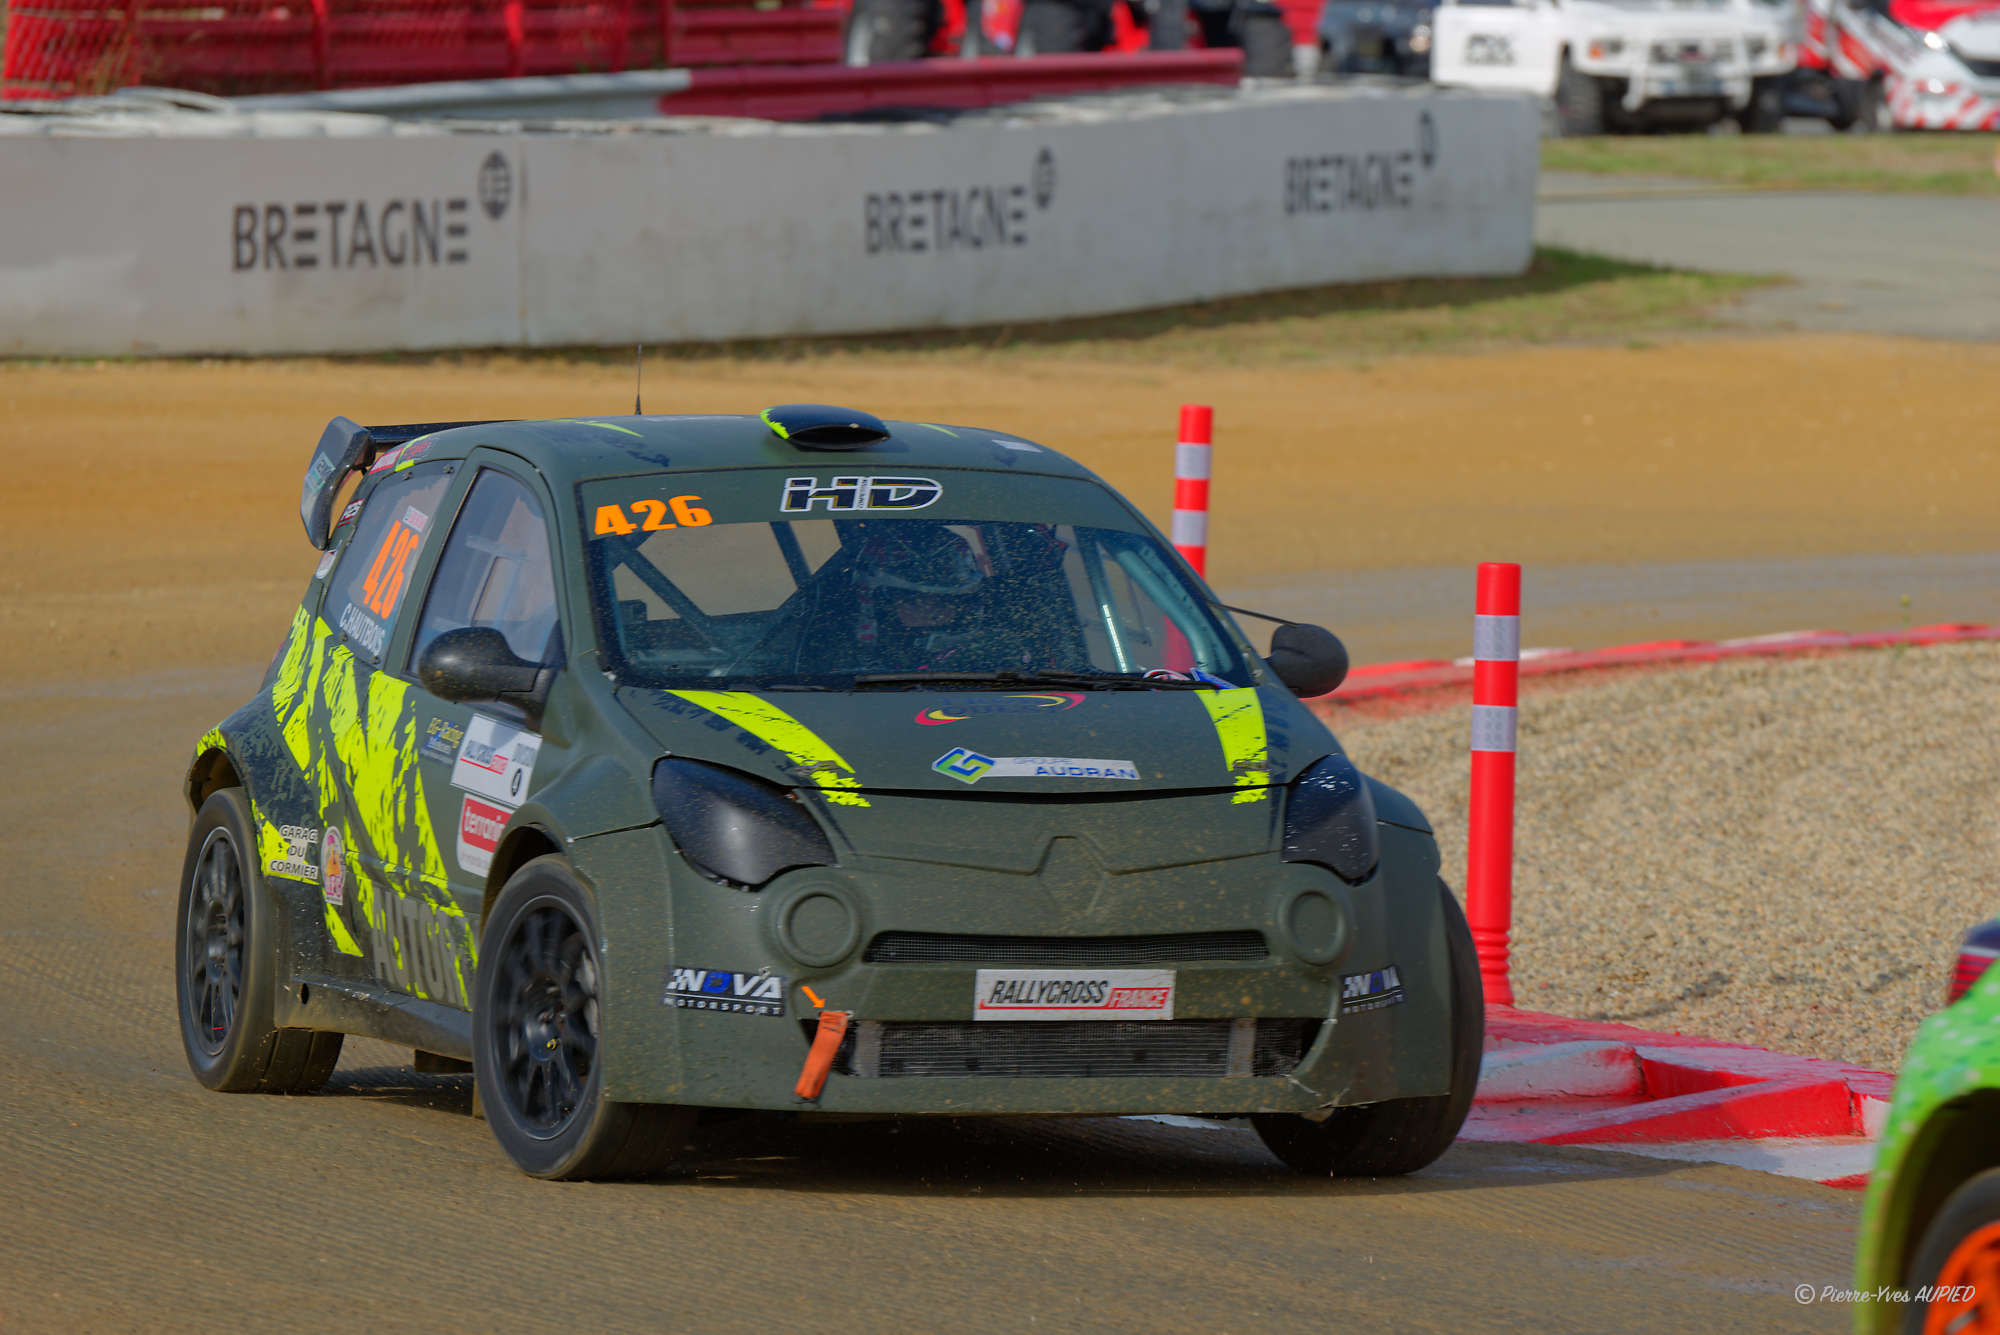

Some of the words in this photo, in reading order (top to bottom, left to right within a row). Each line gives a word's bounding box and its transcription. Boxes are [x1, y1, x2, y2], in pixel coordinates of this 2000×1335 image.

[1285, 151, 1412, 216] BRETAGNE
[234, 198, 468, 271] BRETAGNE
[864, 184, 1027, 253] BRETAGNE
[780, 476, 943, 512] HD
[594, 495, 713, 535] 426
[362, 519, 419, 620] 426
[1034, 765, 1138, 779] AUDRAN
[280, 825, 319, 842] GARAG
[287, 845, 305, 858] DU
[270, 860, 318, 879] CORMIER
[664, 997, 782, 1015] MOTORSPORT
[988, 979, 1109, 1004] RALLYCROSS
[1110, 988, 1168, 1008] FRANCE
